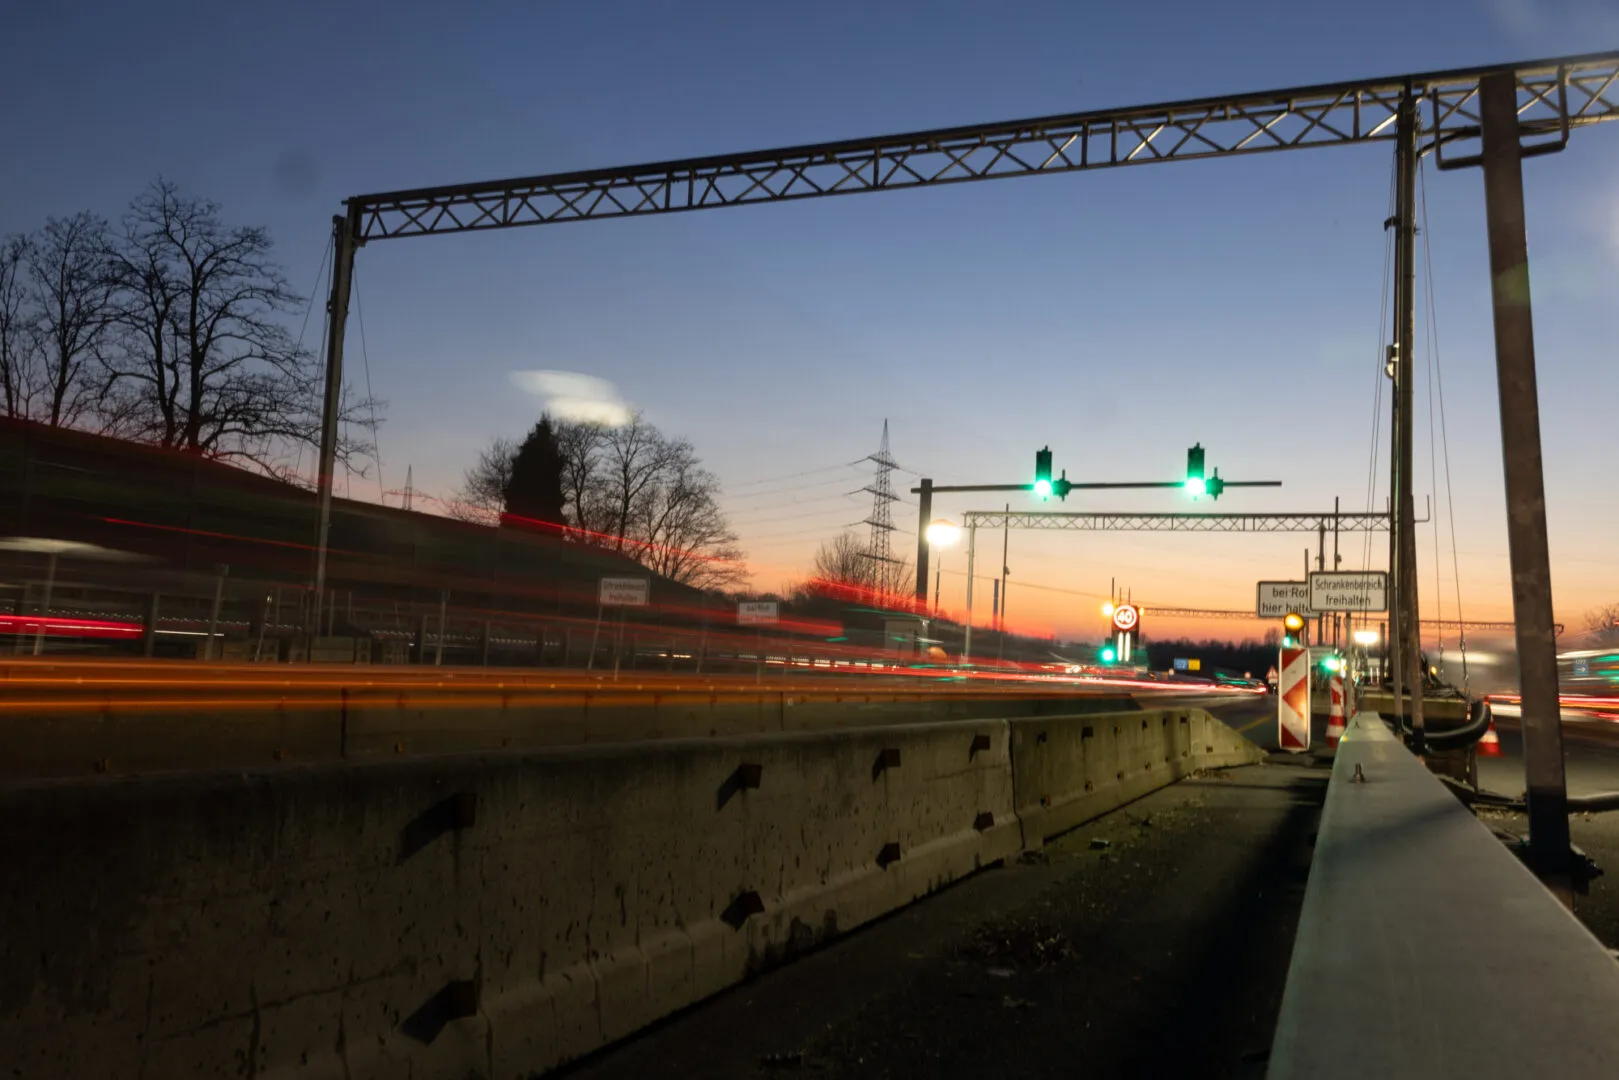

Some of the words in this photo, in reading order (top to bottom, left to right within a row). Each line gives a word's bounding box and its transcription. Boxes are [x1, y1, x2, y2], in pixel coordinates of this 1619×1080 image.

[1315, 578, 1382, 591] Schrankenbereich
[1272, 587, 1288, 598] bei
[1325, 594, 1371, 606] freihalten
[1262, 603, 1282, 613] hier
[1117, 609, 1132, 623] 40
